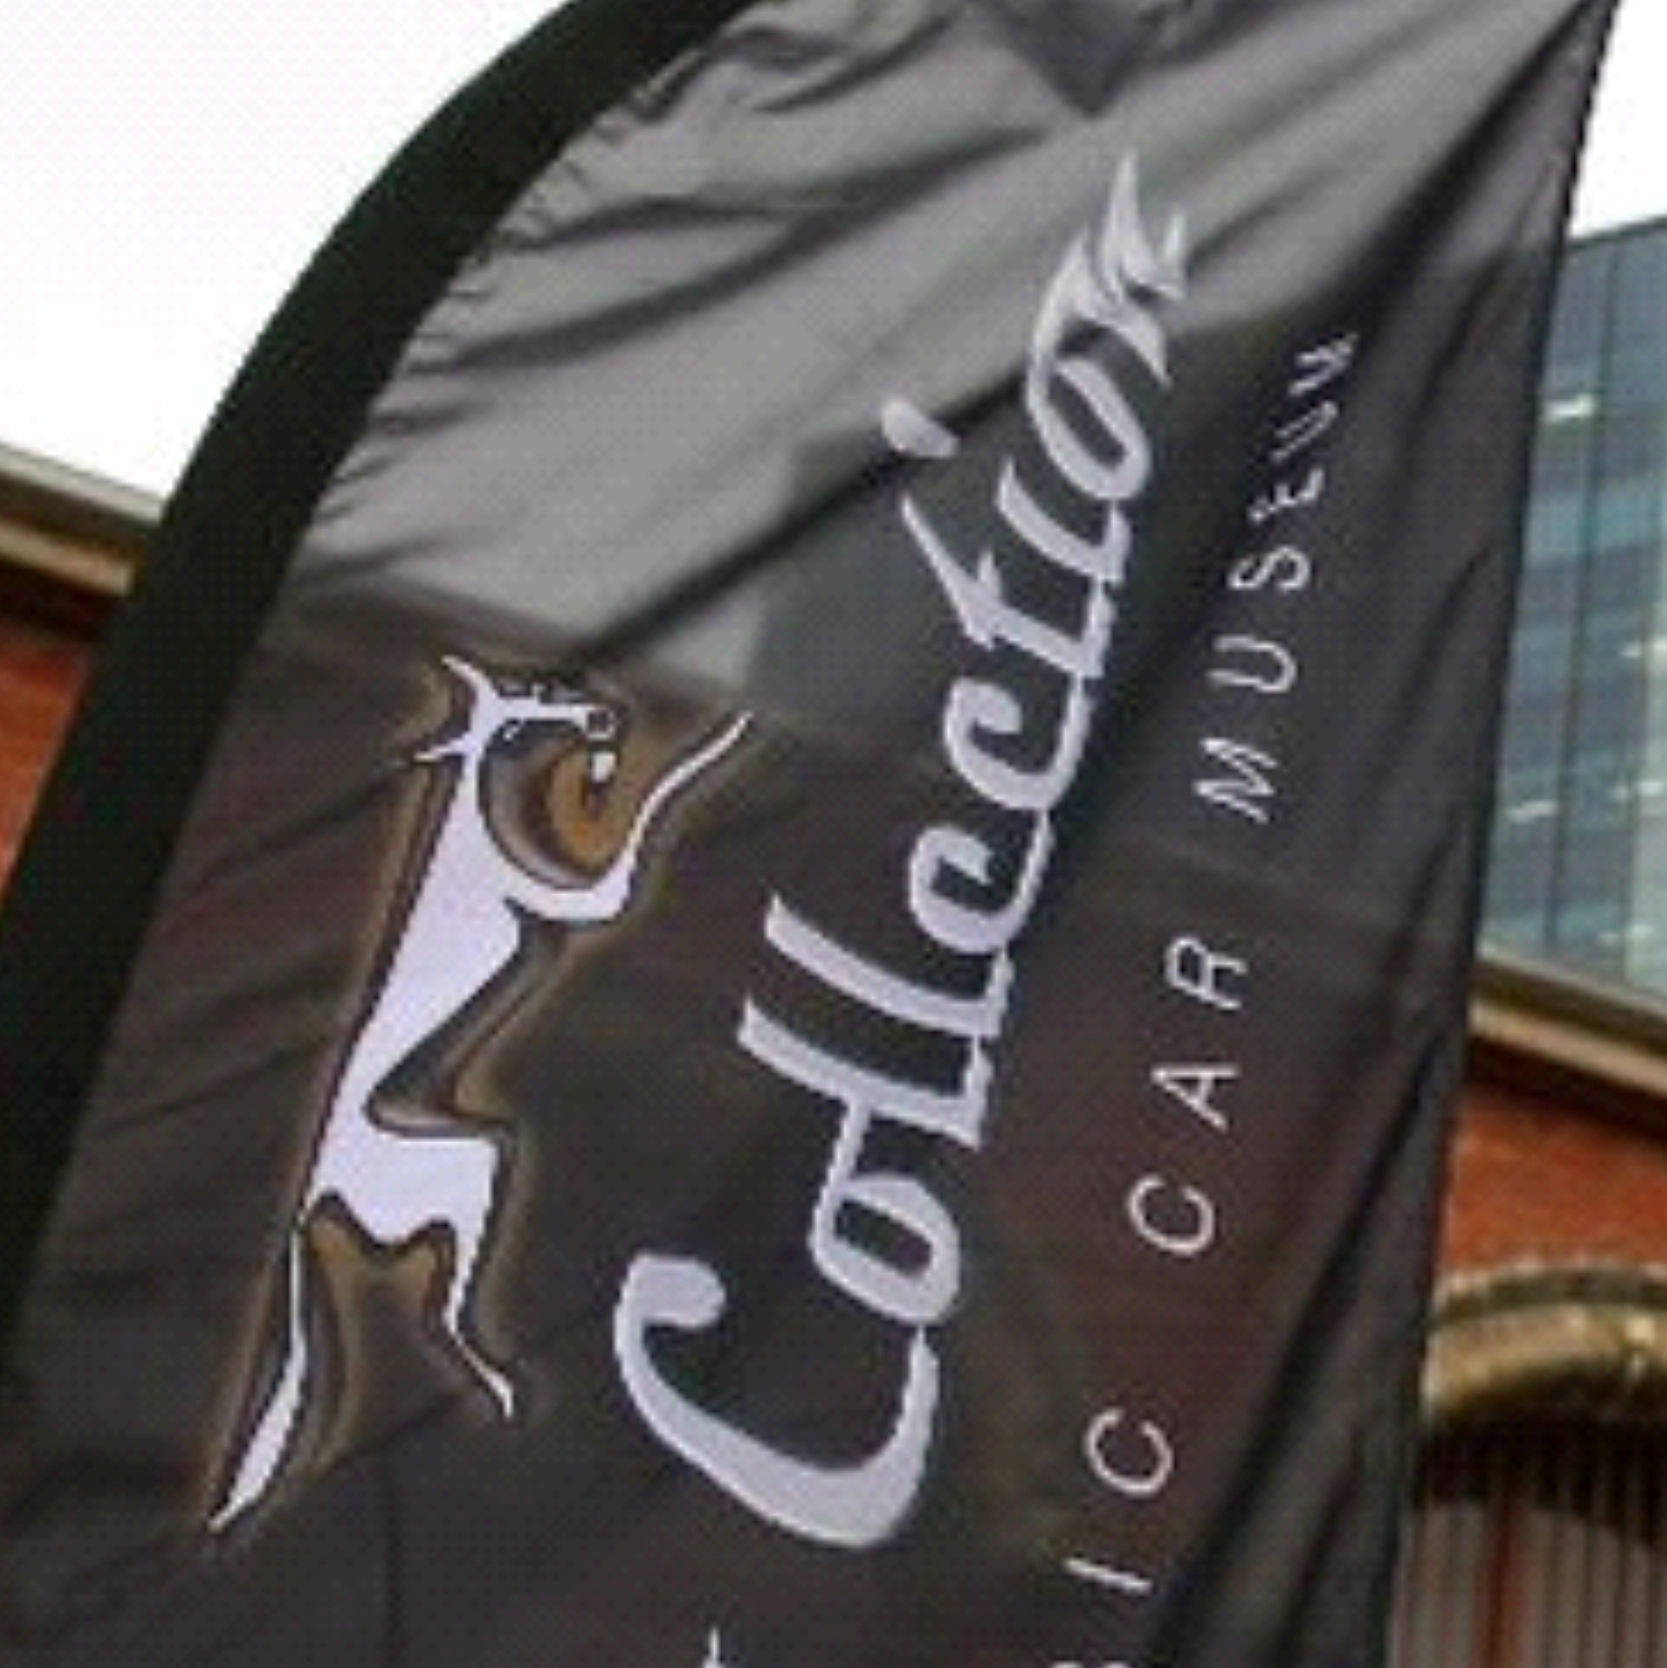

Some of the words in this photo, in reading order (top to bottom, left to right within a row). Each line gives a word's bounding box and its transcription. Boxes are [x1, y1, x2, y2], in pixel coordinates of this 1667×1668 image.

[613, 150, 1187, 1548] Collection
[1126, 936, 1248, 1256] CAR
[1193, 334, 1358, 825] MUSEUM
